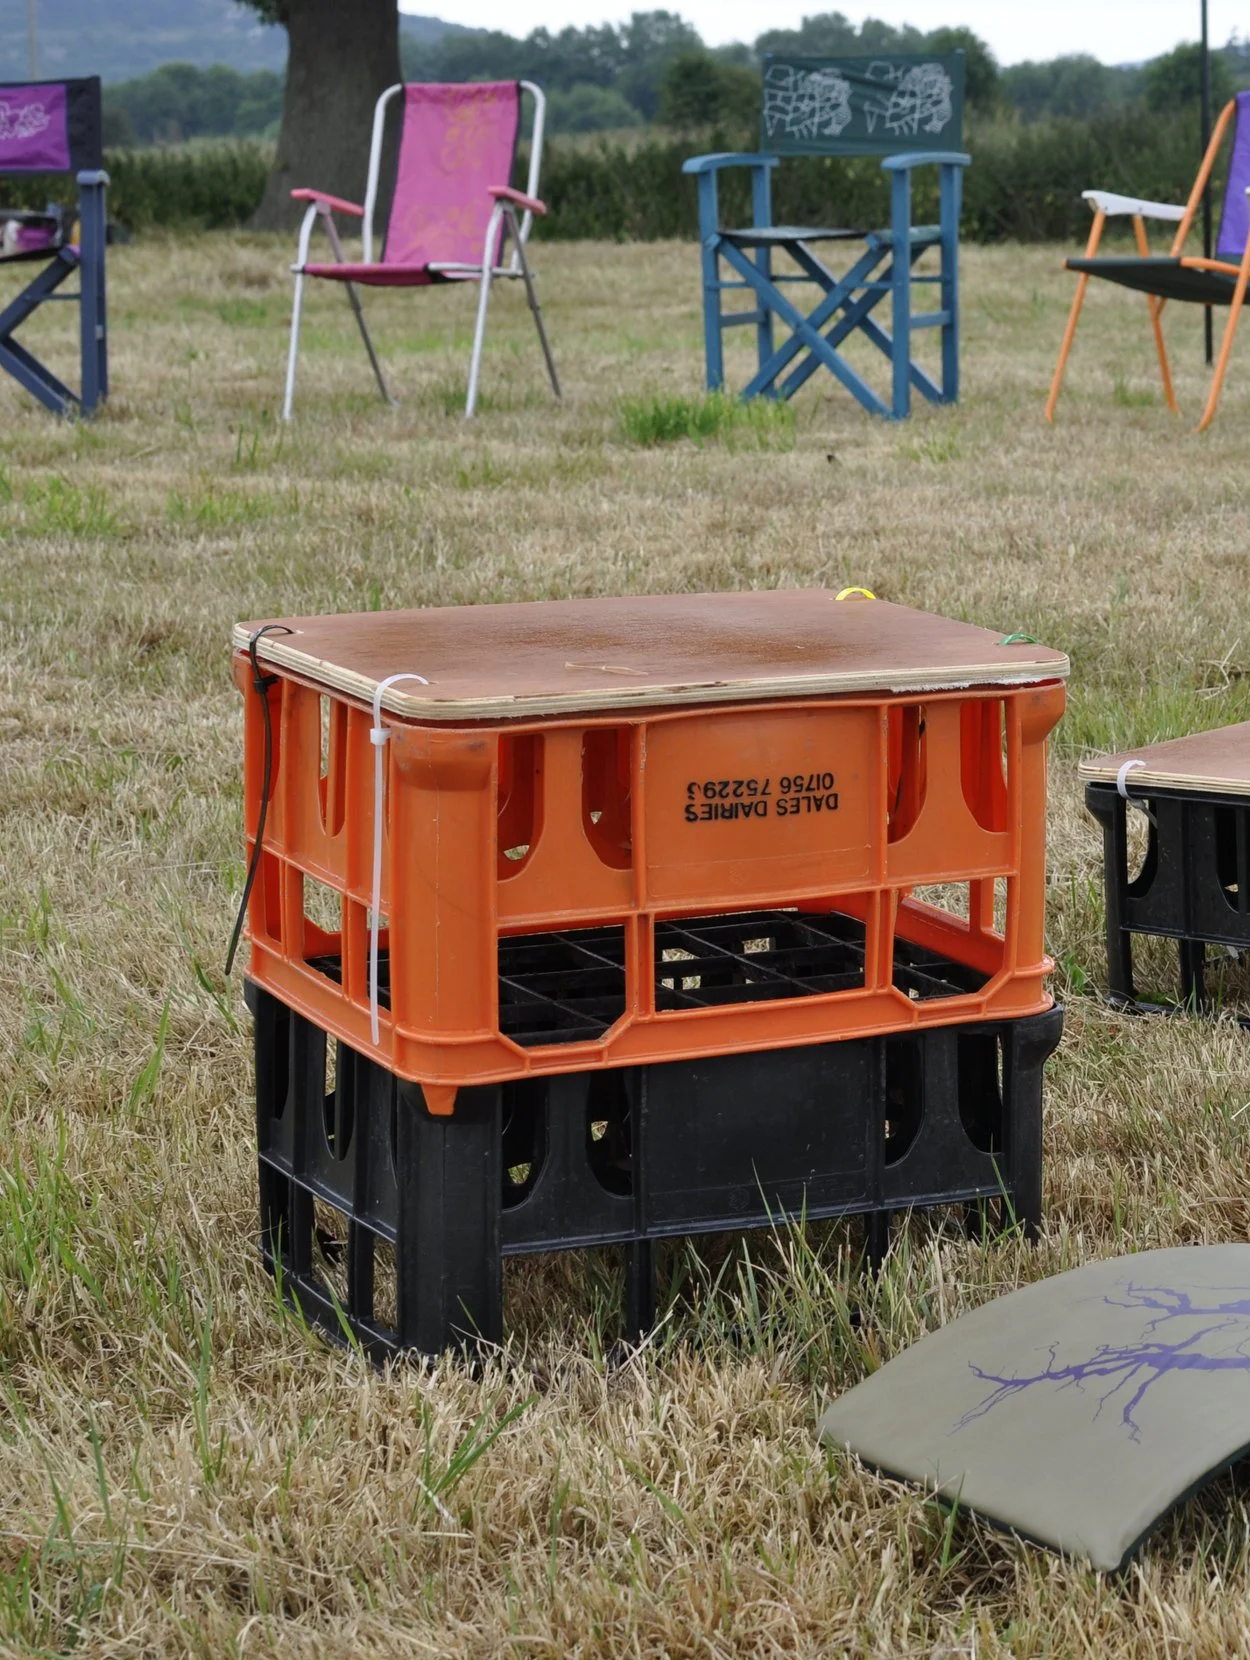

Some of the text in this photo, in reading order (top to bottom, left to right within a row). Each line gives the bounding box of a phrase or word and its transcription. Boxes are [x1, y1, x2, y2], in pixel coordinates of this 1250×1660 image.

[780, 772, 834, 794] 01756
[685, 793, 838, 822] DALES DAIRIES
